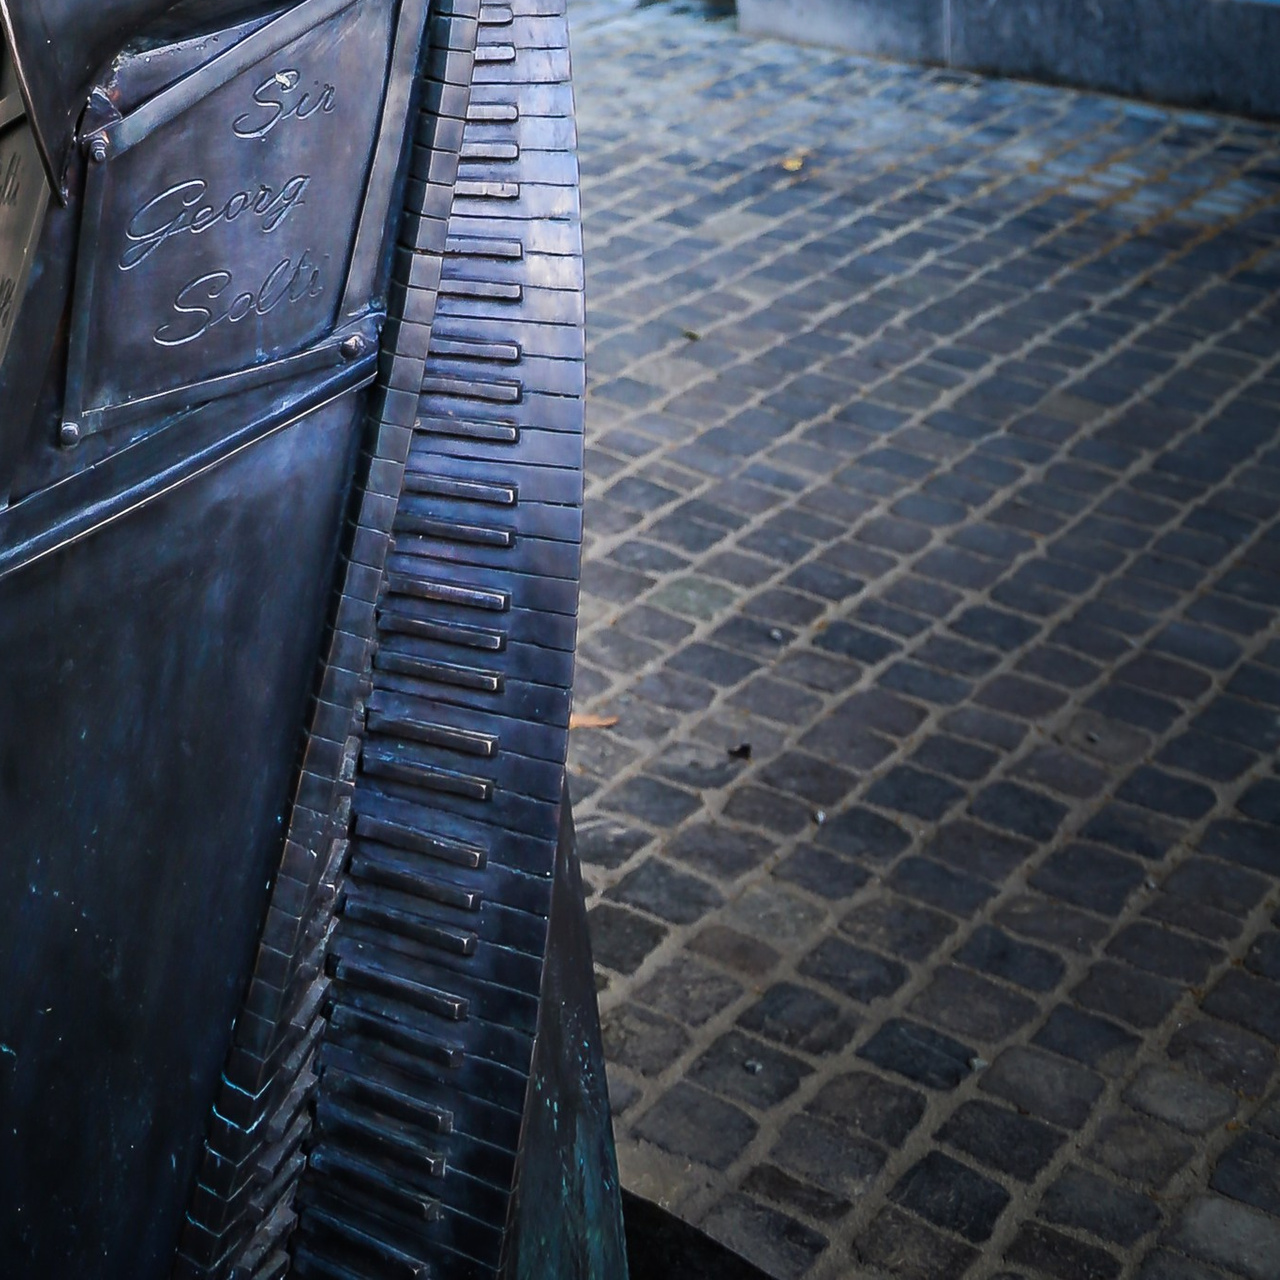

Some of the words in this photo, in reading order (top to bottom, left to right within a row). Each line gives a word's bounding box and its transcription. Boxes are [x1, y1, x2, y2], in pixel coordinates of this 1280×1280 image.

[232, 68, 336, 141] Sir
[118, 173, 311, 270] Georg
[152, 247, 329, 346] Solti
